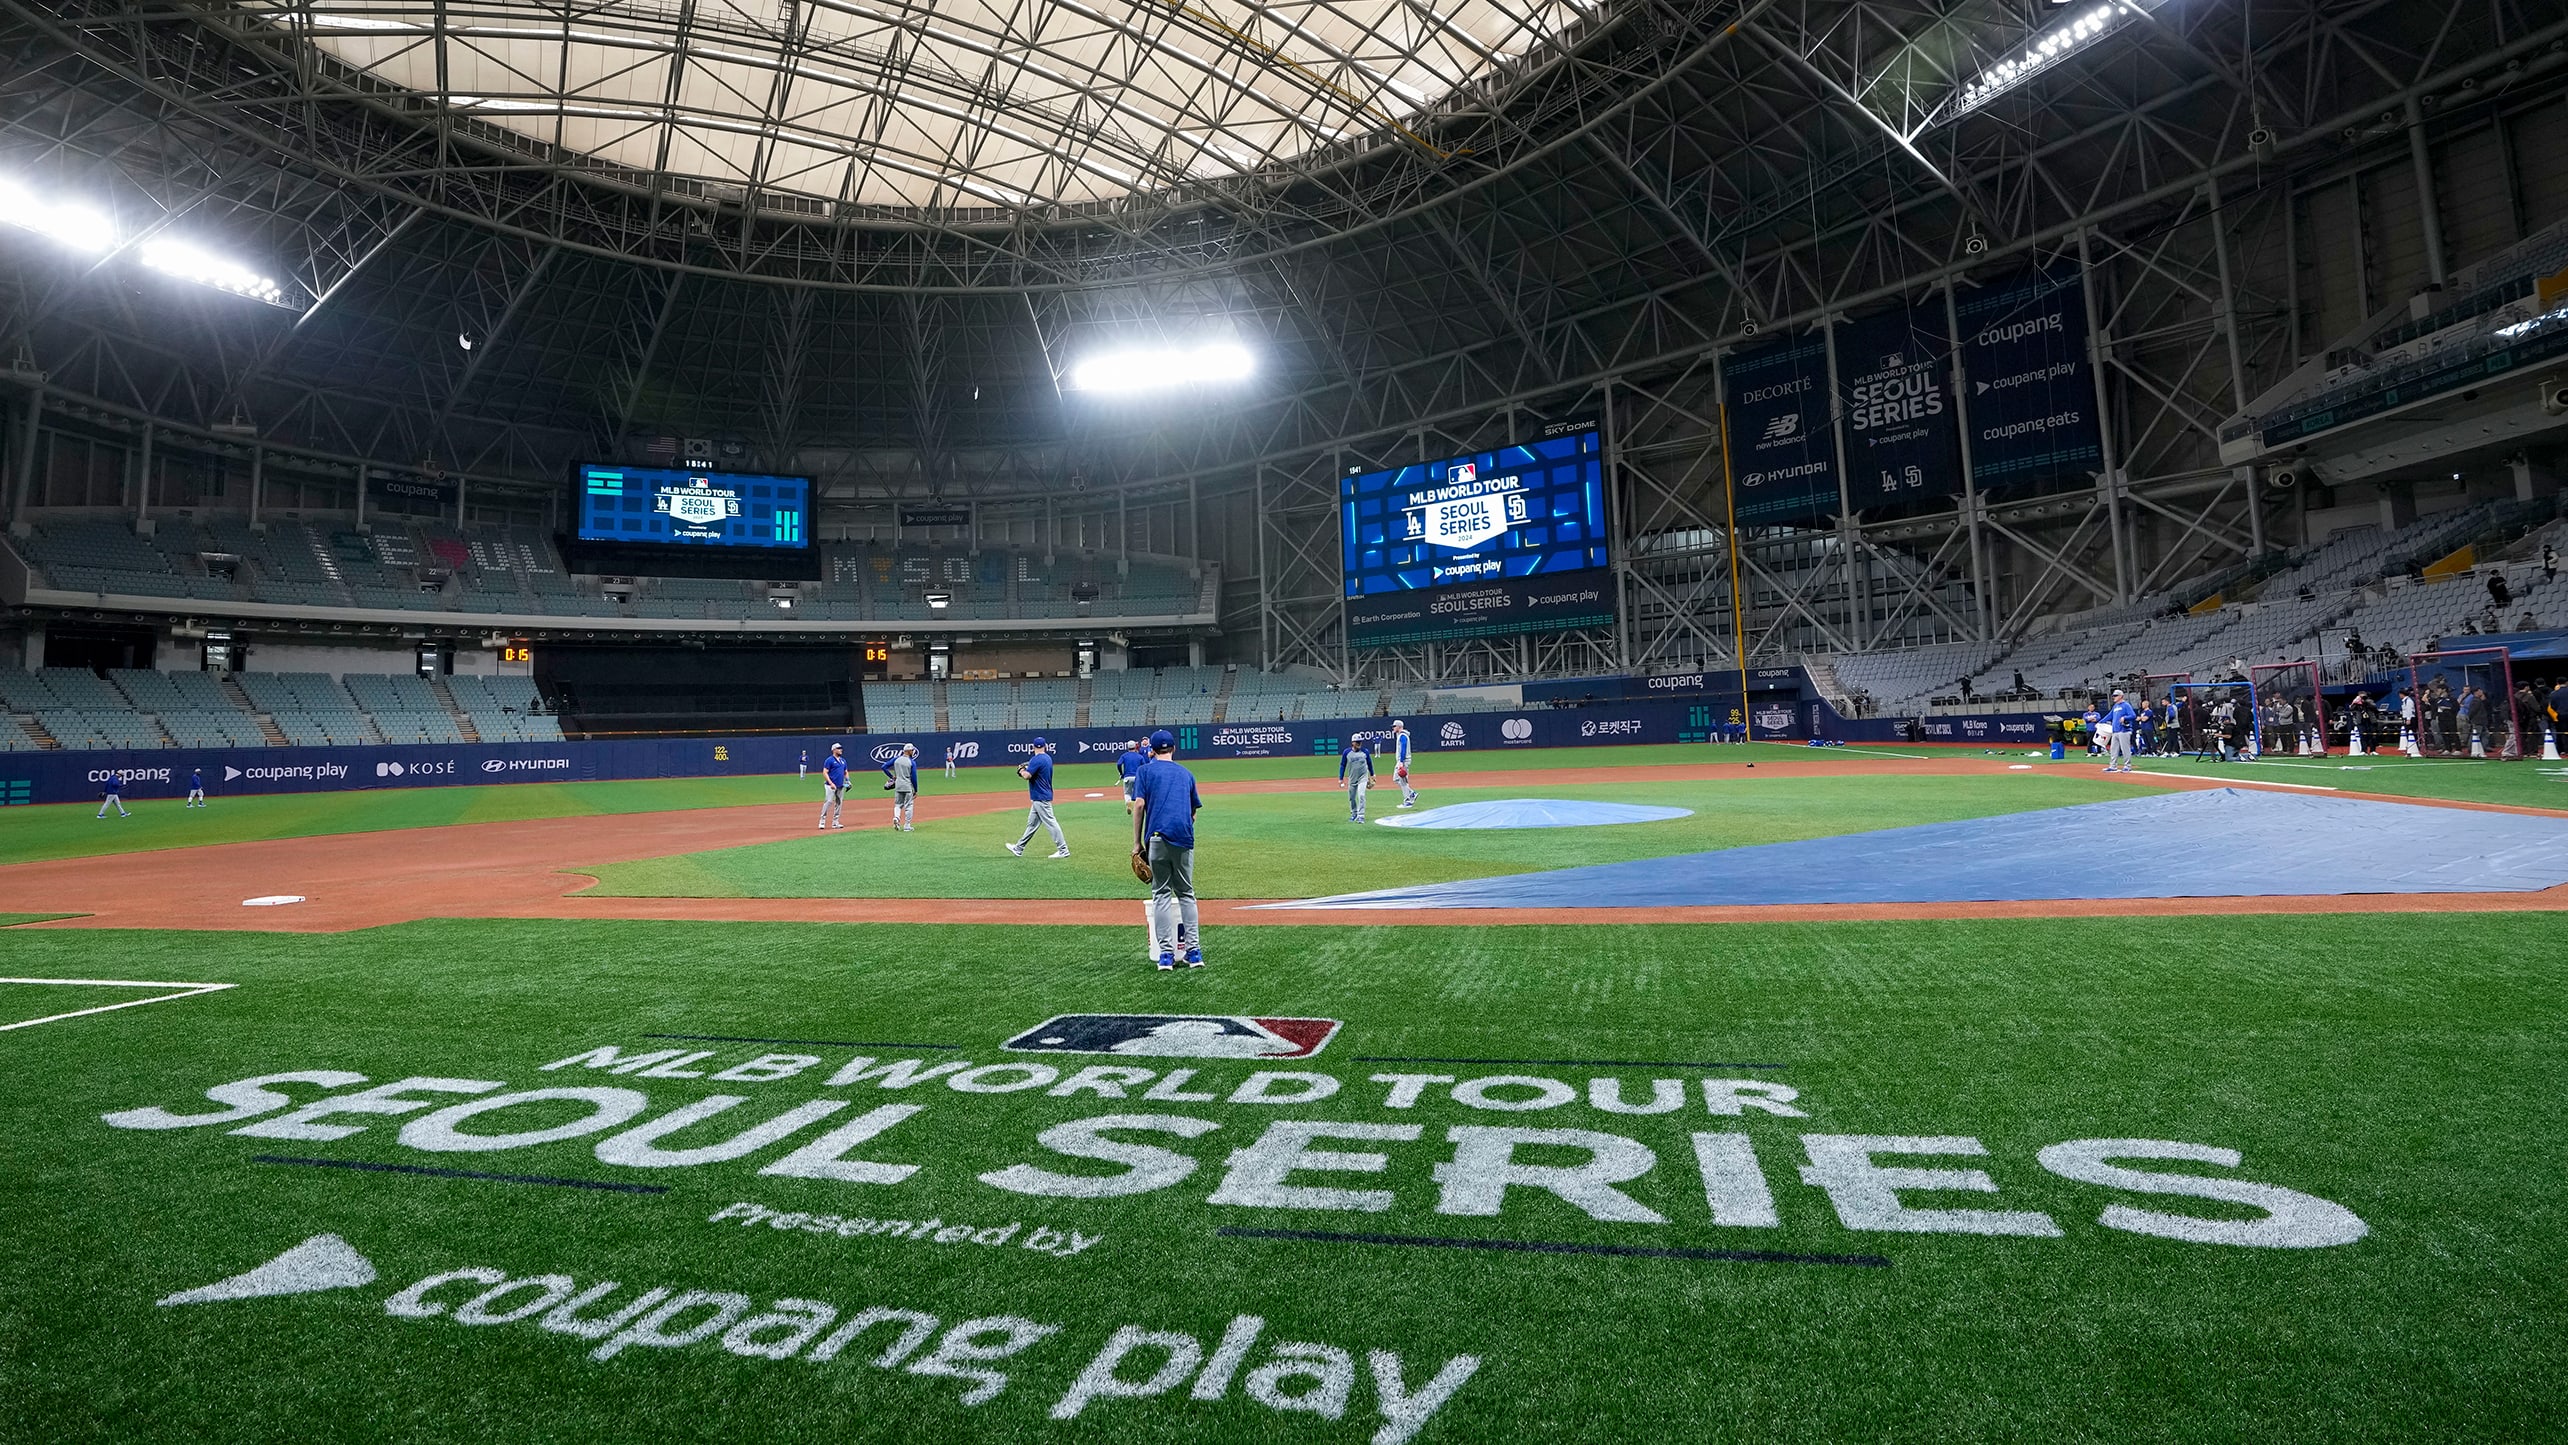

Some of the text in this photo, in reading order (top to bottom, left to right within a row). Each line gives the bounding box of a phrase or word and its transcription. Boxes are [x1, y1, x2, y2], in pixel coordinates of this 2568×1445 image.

[1978, 312, 2063, 347] coupang
[1854, 375, 1874, 386] MLB
[1874, 366, 1907, 382] WORLD
[1993, 362, 2076, 389] coupang play
[1743, 376, 1813, 405] DECORTÉ
[1852, 371, 1939, 409] SEOUL
[1853, 392, 1943, 430] SERIES
[1545, 426, 1565, 436] SKY
[1566, 420, 1597, 432] DOME
[1983, 411, 2080, 441] coupang eats
[1879, 432, 1912, 445] coupang
[1913, 427, 1929, 440] play
[1755, 441, 1772, 451] new
[1768, 461, 1827, 482] HYUNDAI
[386, 482, 439, 500] coupang
[660, 486, 736, 498] MLB WORLD TOUR
[1409, 475, 1519, 506] MLB WORLD TOUR
[681, 498, 715, 507] SEOUL
[681, 506, 716, 516] SERIES
[1440, 501, 1489, 520] SEOUL
[916, 514, 964, 523] coupang play
[1407, 511, 1423, 535] LA
[1440, 516, 1491, 536] SERIES
[682, 530, 721, 539] coupang play
[1458, 534, 1473, 542] 2024
[1444, 560, 1502, 578] coupang play
[1447, 588, 1503, 601] MLB WORLD TOUR
[1540, 589, 1599, 605] coupang play
[1430, 595, 1512, 614] SEOUL SERIES
[1361, 610, 1421, 624] Earth Corporation
[505, 648, 529, 661] 0:15
[866, 648, 887, 661] 0:15
[1648, 674, 1704, 691] coupang
[1758, 668, 1789, 679] coupang
[1597, 719, 1642, 735] 로켓직구
[1962, 720, 1973, 729] MLB
[1007, 742, 1057, 755] coupng
[1212, 733, 1293, 746] SEOUL SERIES
[952, 741, 980, 761] JTB
[246, 762, 349, 781] coupang play
[409, 760, 456, 775] KOSÉ
[509, 758, 570, 770] HYUNDAI
[537, 1045, 1809, 1118] MLB WORLD TOUR
[100, 1069, 2370, 1250] SEOUL SERIES
[708, 1202, 1104, 1257] Presented by
[383, 1266, 1484, 1445] coupang play
